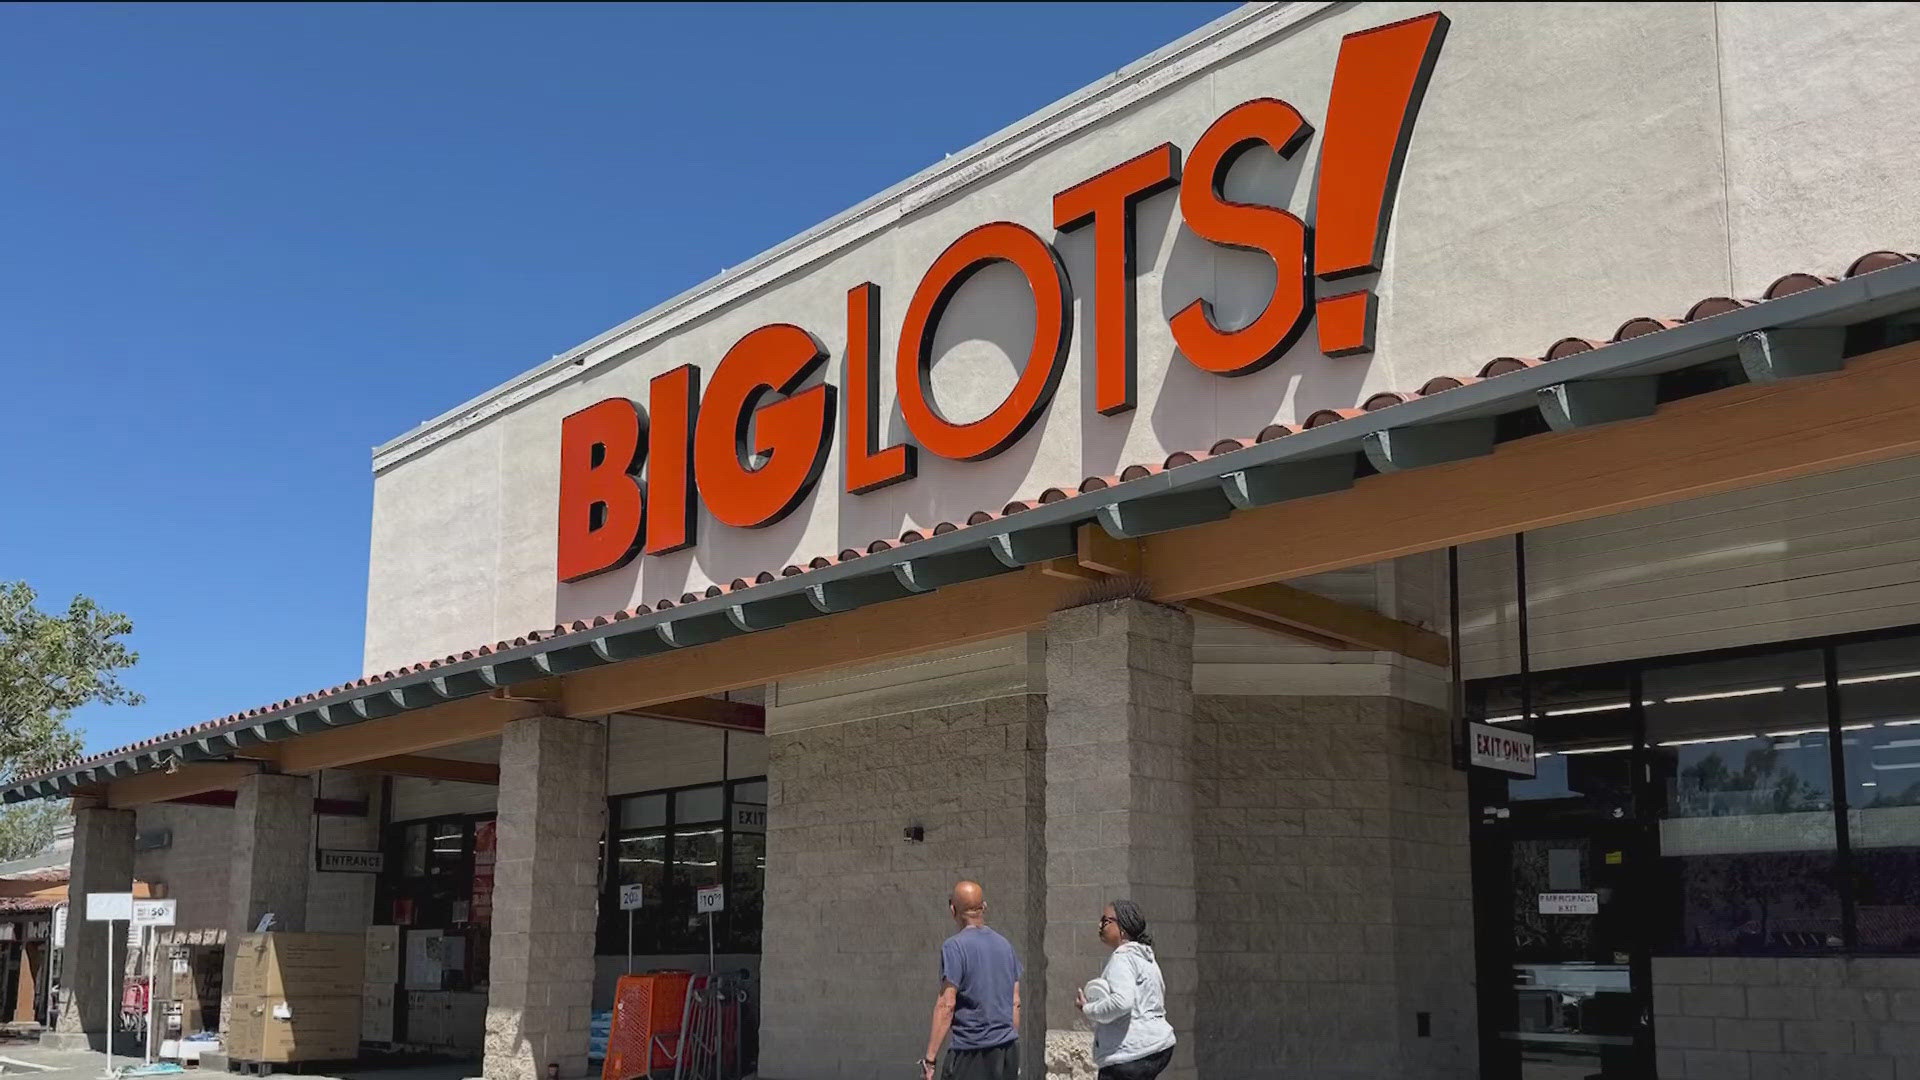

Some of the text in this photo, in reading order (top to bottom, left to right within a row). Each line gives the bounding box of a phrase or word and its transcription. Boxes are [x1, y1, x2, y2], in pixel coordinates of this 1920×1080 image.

[558, 11, 1450, 584] BIG LOTS!
[1477, 733, 1531, 763] EXIT ONLY
[739, 810, 766, 825] EXIT
[325, 854, 381, 867] ENTRANCE
[1540, 895, 1596, 903] EMERGENCY
